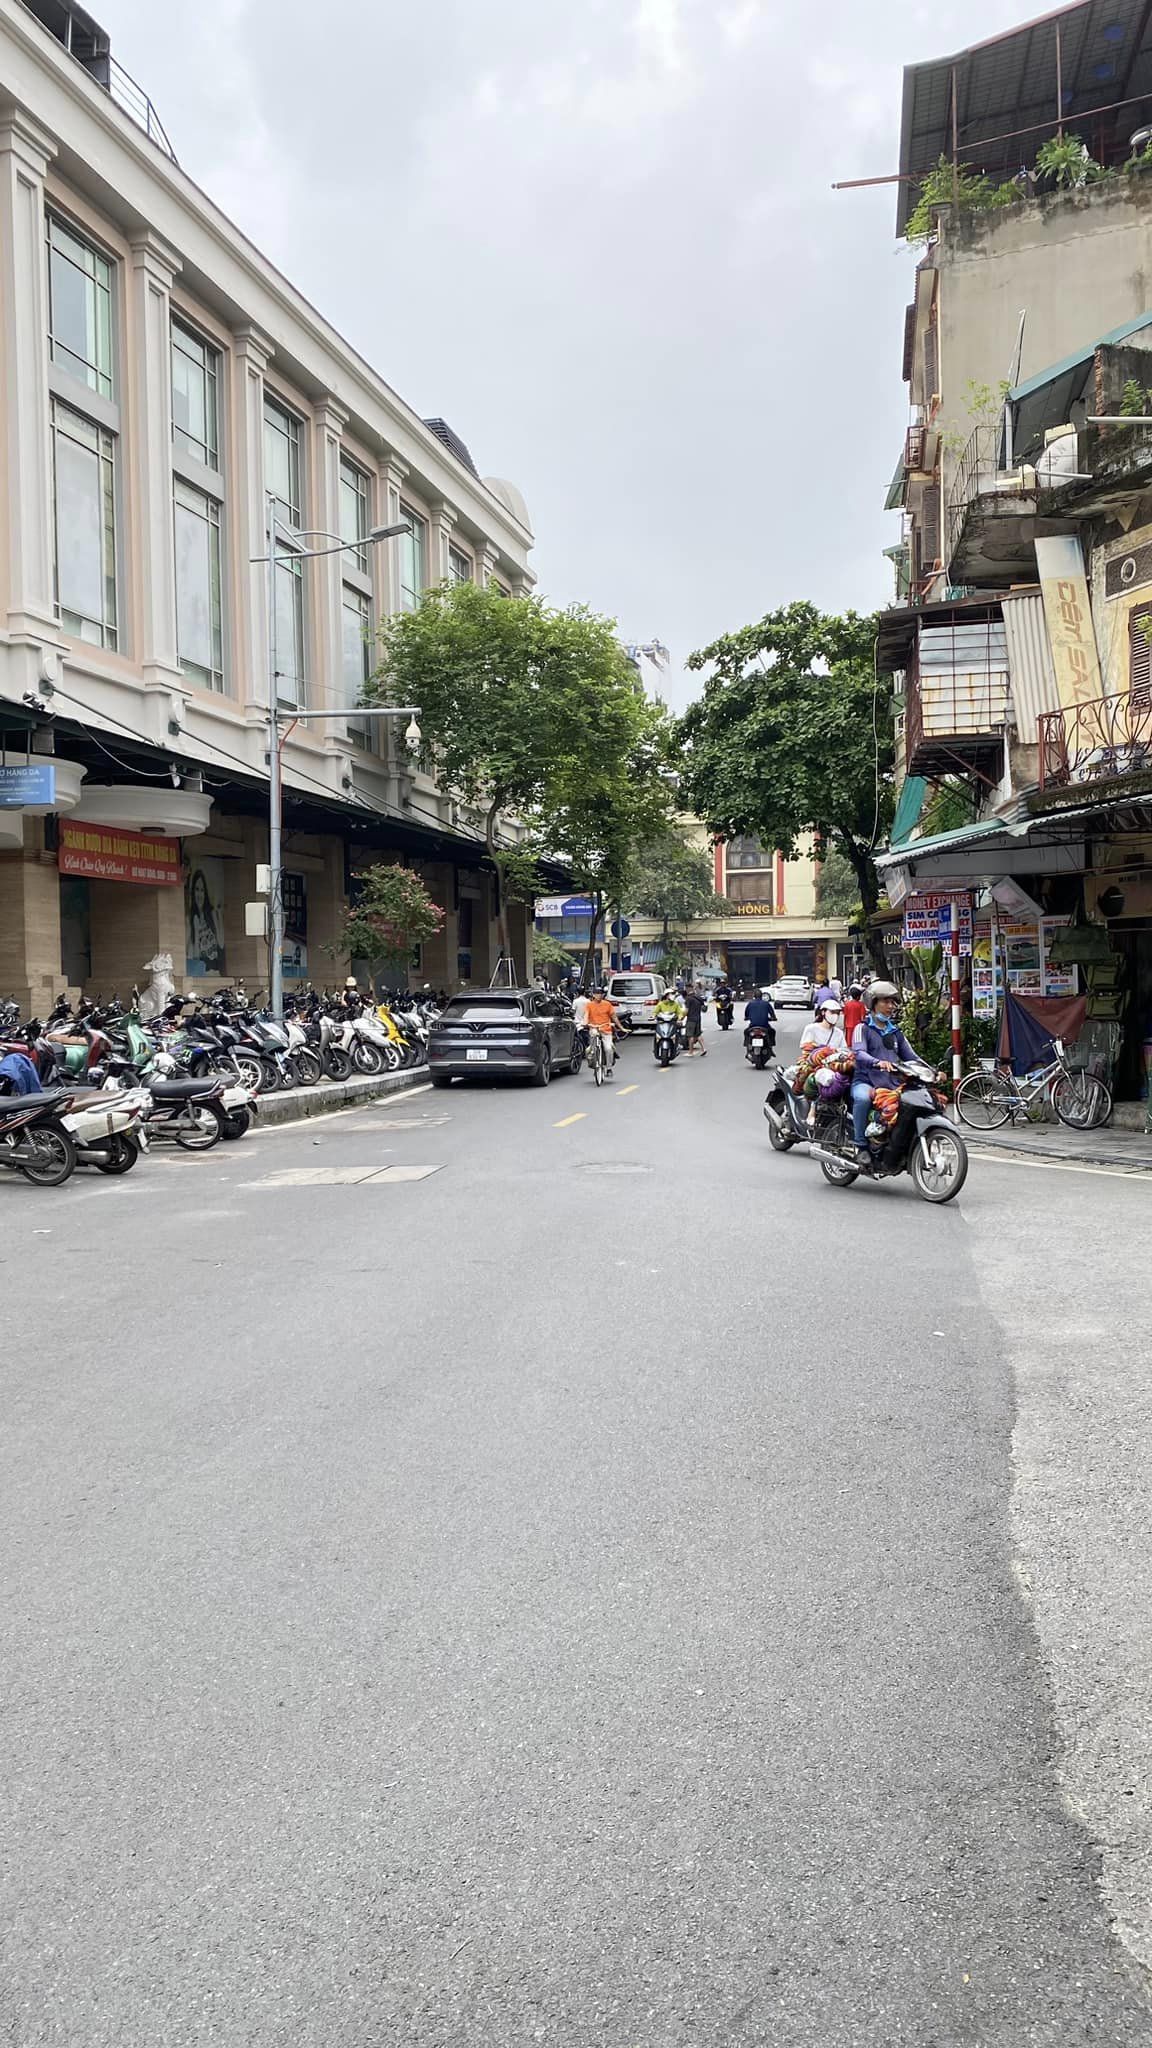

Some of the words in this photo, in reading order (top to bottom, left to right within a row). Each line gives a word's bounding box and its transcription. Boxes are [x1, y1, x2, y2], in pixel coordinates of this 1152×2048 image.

[906, 896, 932, 910] MONEY
[933, 894, 971, 908] EXCHANGE
[907, 910, 925, 920] SIM
[907, 920, 927, 929] TAXI
